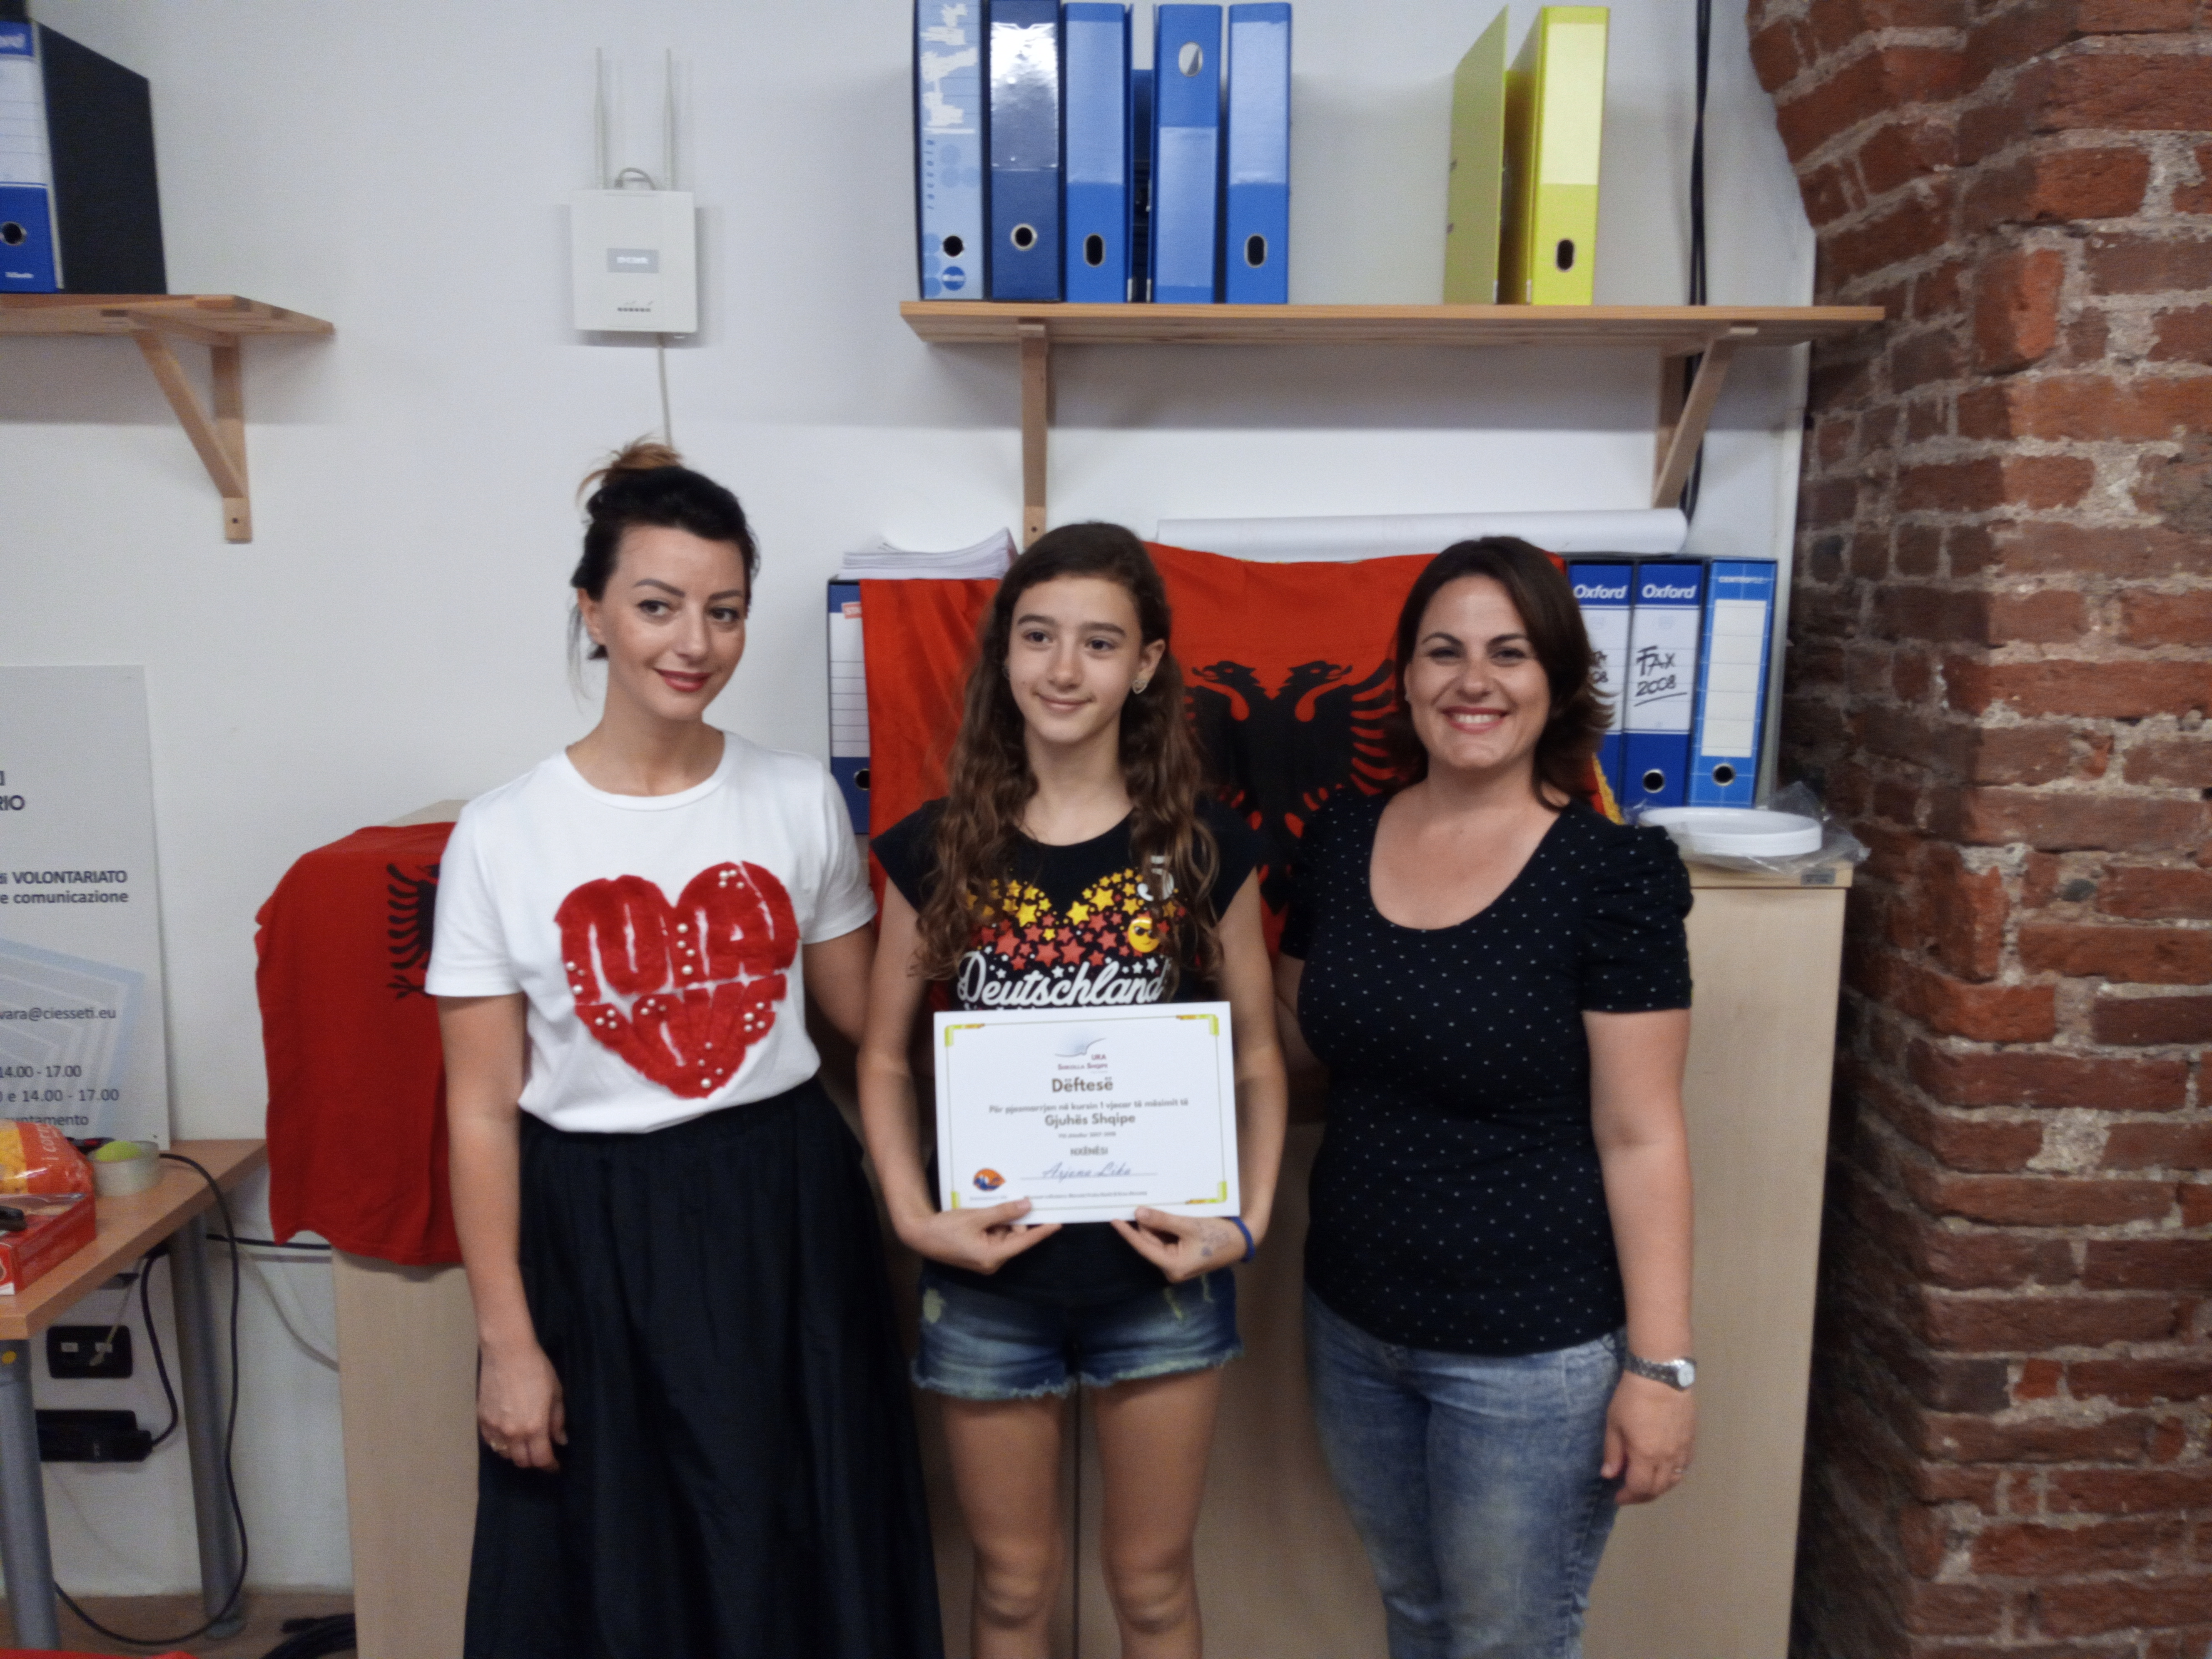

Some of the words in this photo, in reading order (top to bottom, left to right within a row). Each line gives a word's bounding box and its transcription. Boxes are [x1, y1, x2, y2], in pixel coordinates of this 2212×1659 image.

[1573, 584, 1628, 598] Oxford
[1642, 584, 1697, 598] Oxford
[1637, 645, 1675, 676] FAX
[1635, 675, 1676, 697] 2008
[12, 870, 128, 884] VOLONTARIATO
[13, 890, 129, 903] comunicazione
[958, 951, 1169, 1005] Deutschland
[46, 1065, 82, 1078] 17.00
[1052, 1076, 1113, 1093] Dëftesë
[7, 1093, 17, 1102] e
[22, 1090, 63, 1102] 14.00
[79, 1089, 120, 1101] 17.00
[1044, 1113, 1088, 1129] Gjuhës
[1091, 1112, 1136, 1127] Shqipe
